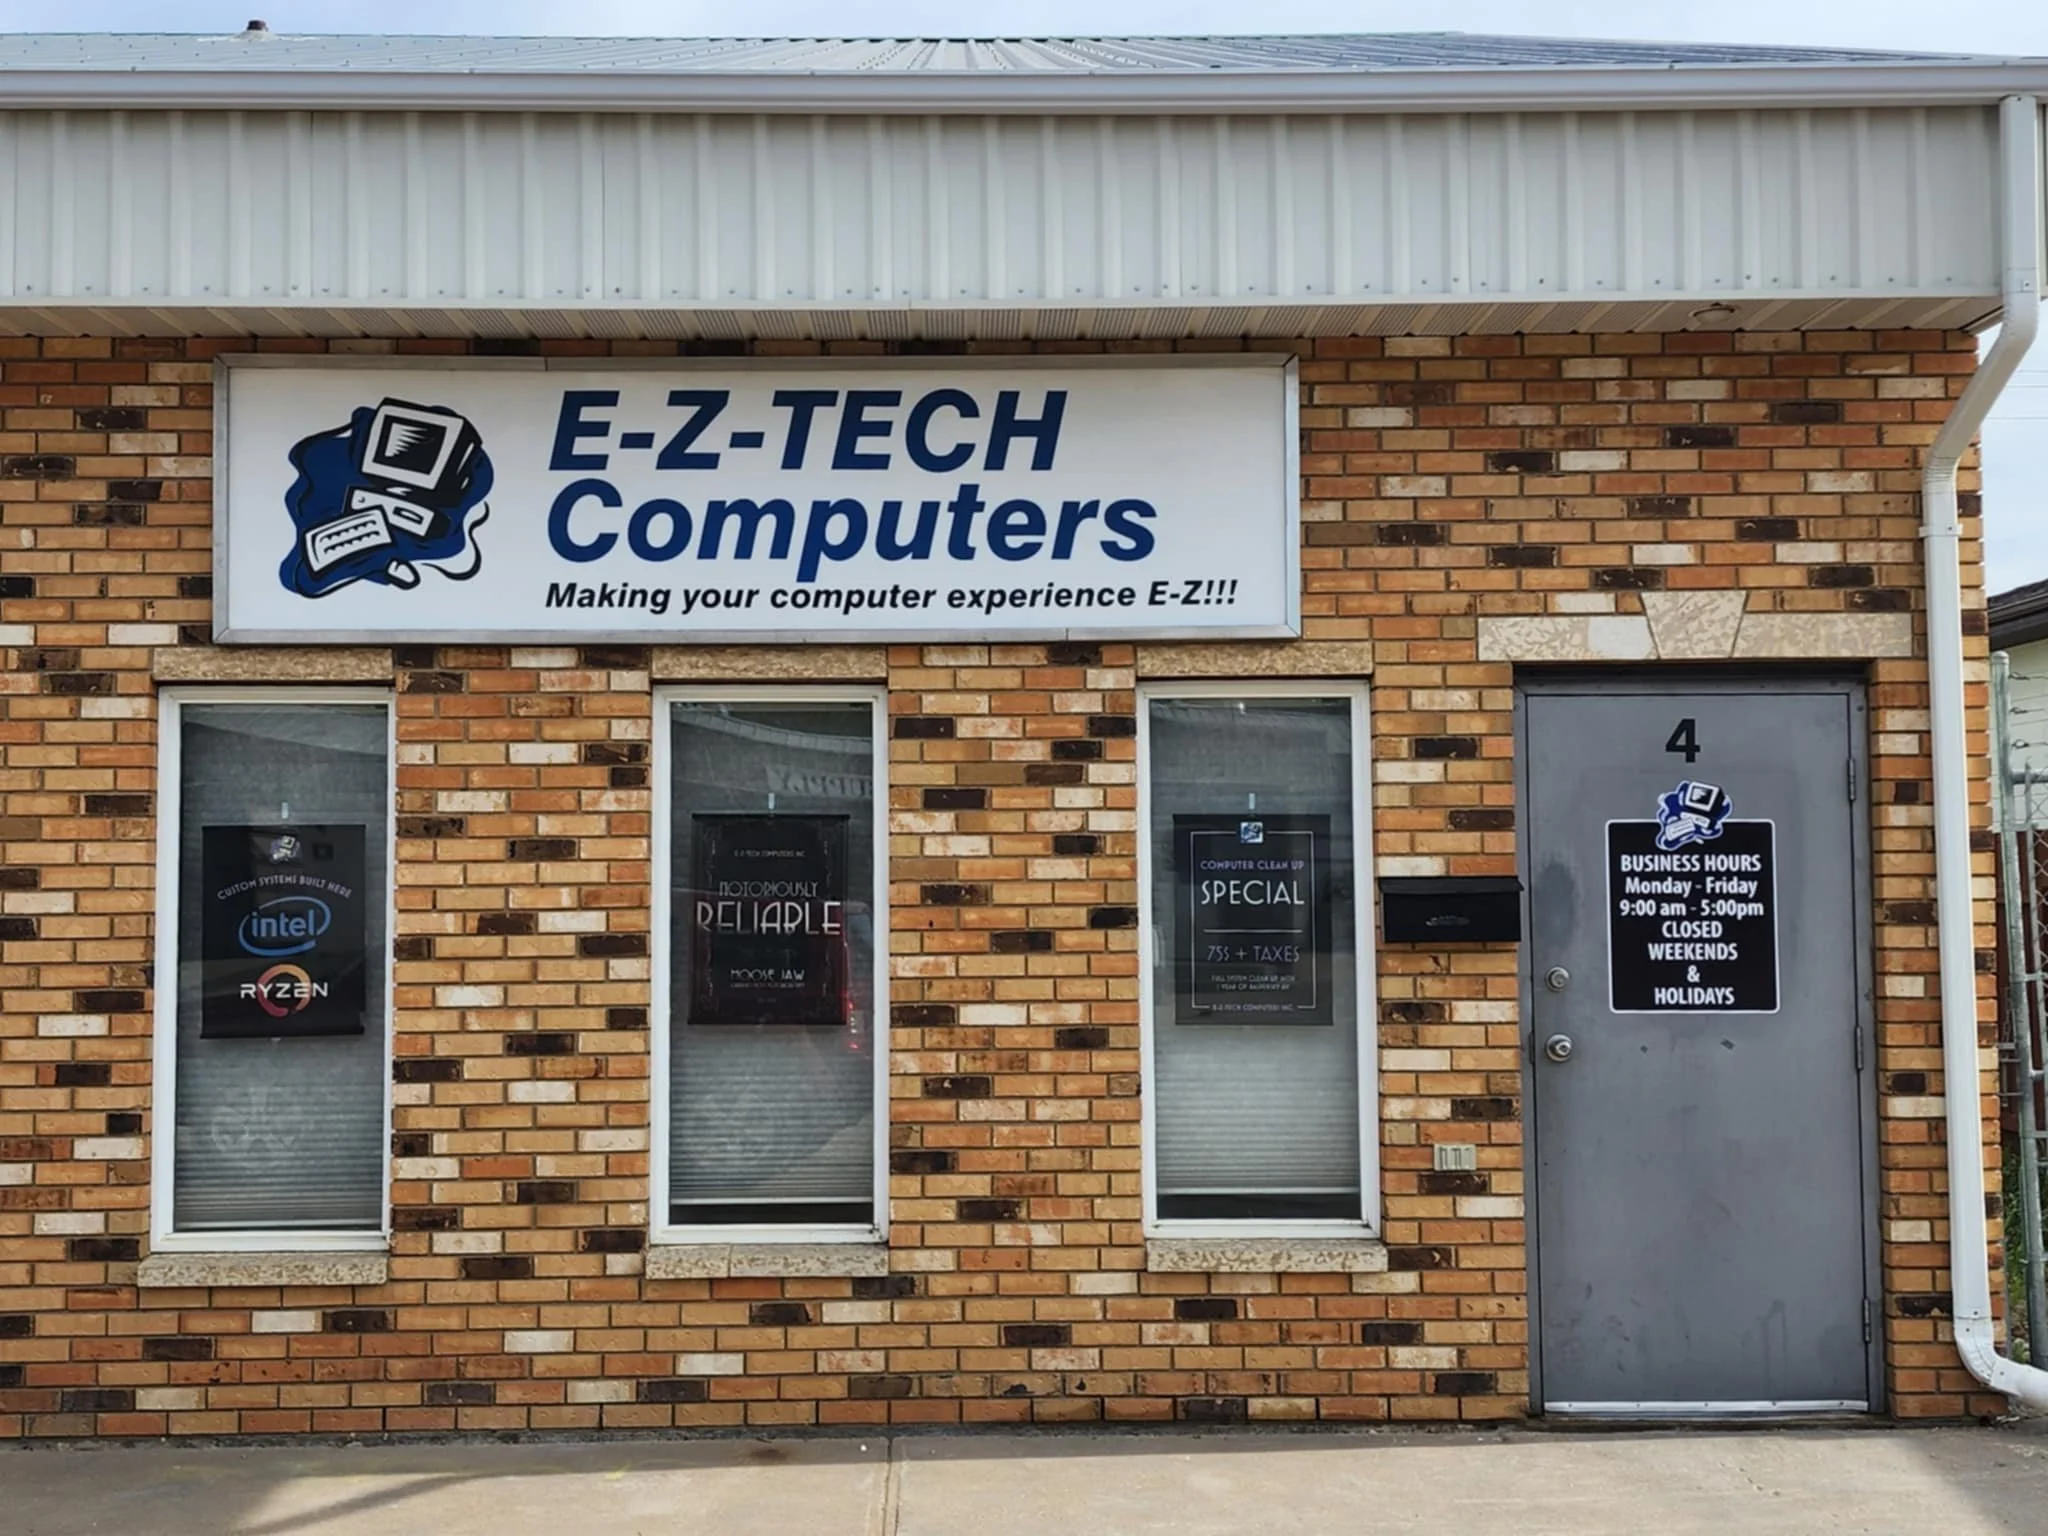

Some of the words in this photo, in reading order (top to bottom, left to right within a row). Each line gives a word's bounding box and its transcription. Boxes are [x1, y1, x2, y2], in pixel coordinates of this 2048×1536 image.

[549, 388, 1068, 473] E-Z-TECH
[548, 478, 1157, 583] Computers
[545, 582, 671, 615] Making
[682, 588, 760, 615] your
[770, 584, 936, 615] computer
[946, 582, 1136, 615] experience
[1148, 579, 1238, 606] E-Z!!!
[1665, 718, 1701, 763] 4
[1200, 860, 1254, 870] COMPUTER
[1256, 860, 1288, 870] CLEAN
[1290, 860, 1304, 870] UP
[1620, 854, 1700, 872] BUSINESS
[1704, 854, 1761, 872] HOURS
[217, 880, 257, 900] CUSTOM
[259, 875, 297, 887] SYSTEMS
[299, 875, 325, 889] BUILT
[327, 882, 352, 899] HERE
[719, 881, 818, 897] NOTORIOUSLY
[1201, 880, 1305, 905] SPECIAL
[1625, 876, 1692, 898] Monday
[1705, 876, 1758, 898] Friday
[697, 901, 841, 935] RELIABLE
[1619, 899, 1656, 916] 9:00
[1660, 902, 1686, 916] am
[1700, 899, 1764, 920] 5:00pm
[252, 910, 315, 937] intel
[1661, 920, 1723, 938] CLOSED
[1235, 947, 1249, 961] +
[1253, 945, 1300, 962] TAXES
[1647, 943, 1738, 960] WEEKENDS
[730, 968, 775, 982] MOOSE
[780, 968, 806, 982] JAW
[1687, 965, 1700, 983] &
[240, 982, 328, 999] RYZEN
[1654, 987, 1735, 1004] HOLIDAYS
